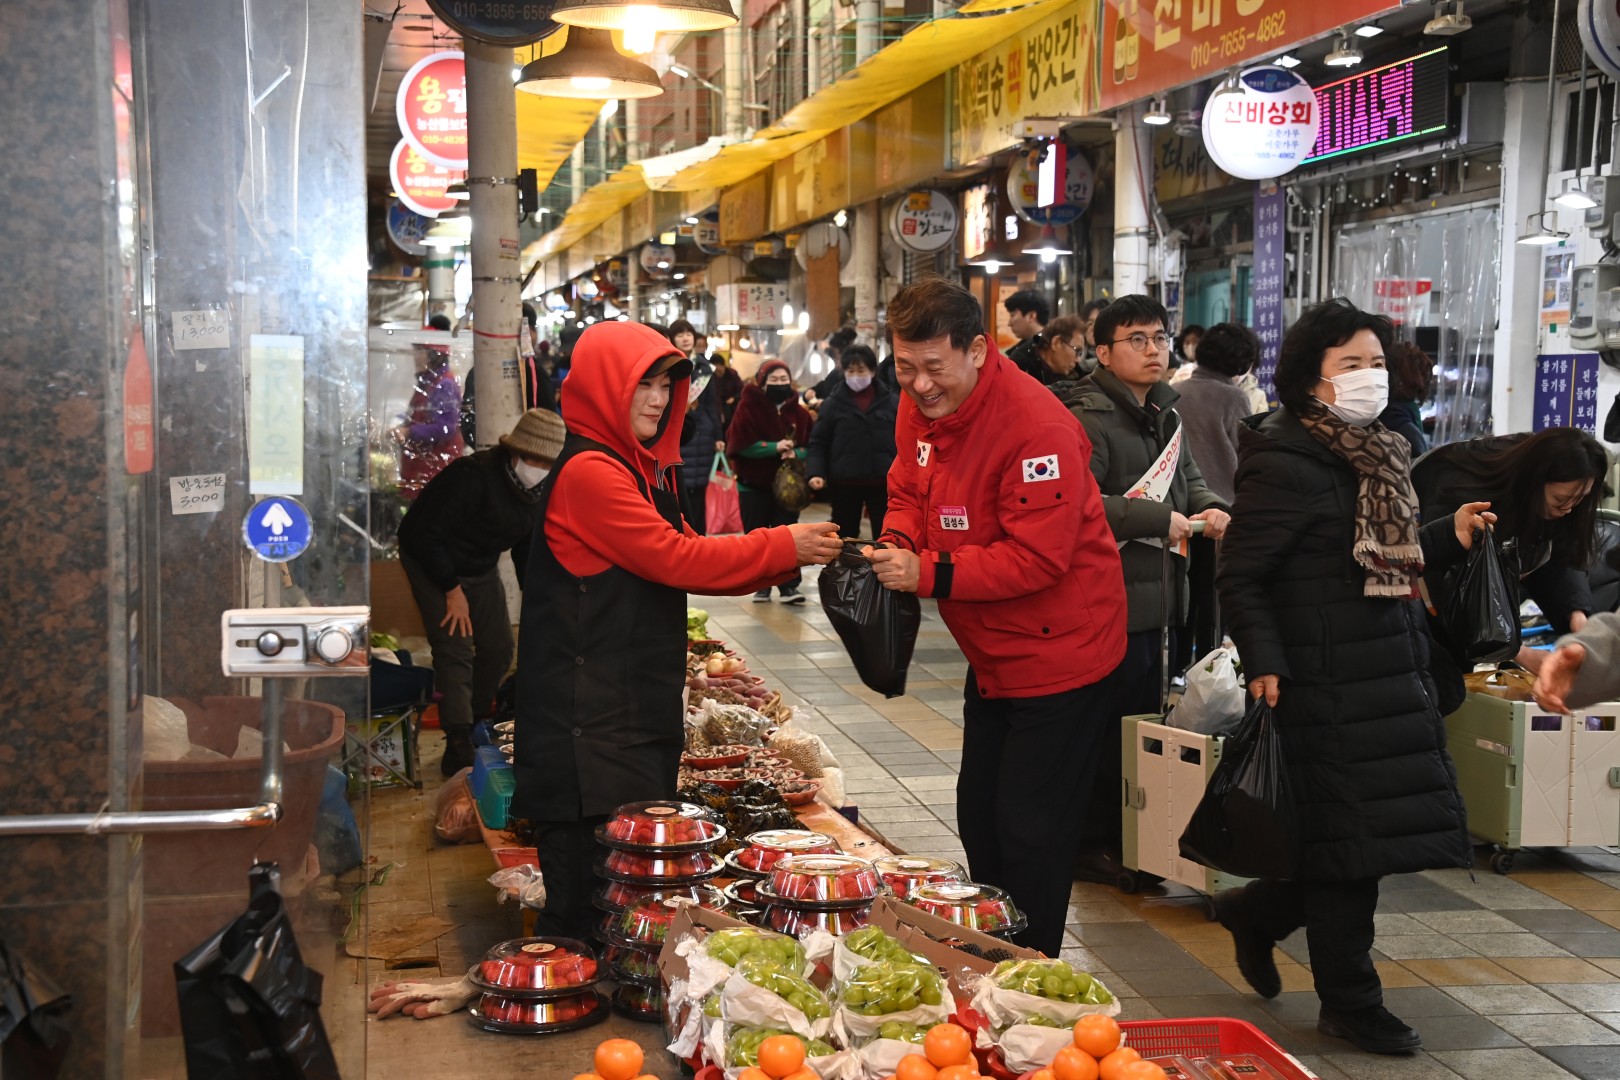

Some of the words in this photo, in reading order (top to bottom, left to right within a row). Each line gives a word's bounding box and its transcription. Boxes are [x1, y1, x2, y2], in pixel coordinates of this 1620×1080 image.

[1191, 9, 1286, 70] 010-7655-4862
[977, 56, 1003, 117] 백송
[1008, 48, 1021, 106] 떡
[1027, 14, 1079, 101] 방앗간
[1225, 101, 1307, 125] 신비상회
[1543, 360, 1567, 374] 참기름
[1541, 378, 1566, 393] 들기름
[943, 517, 965, 528] 김성수
